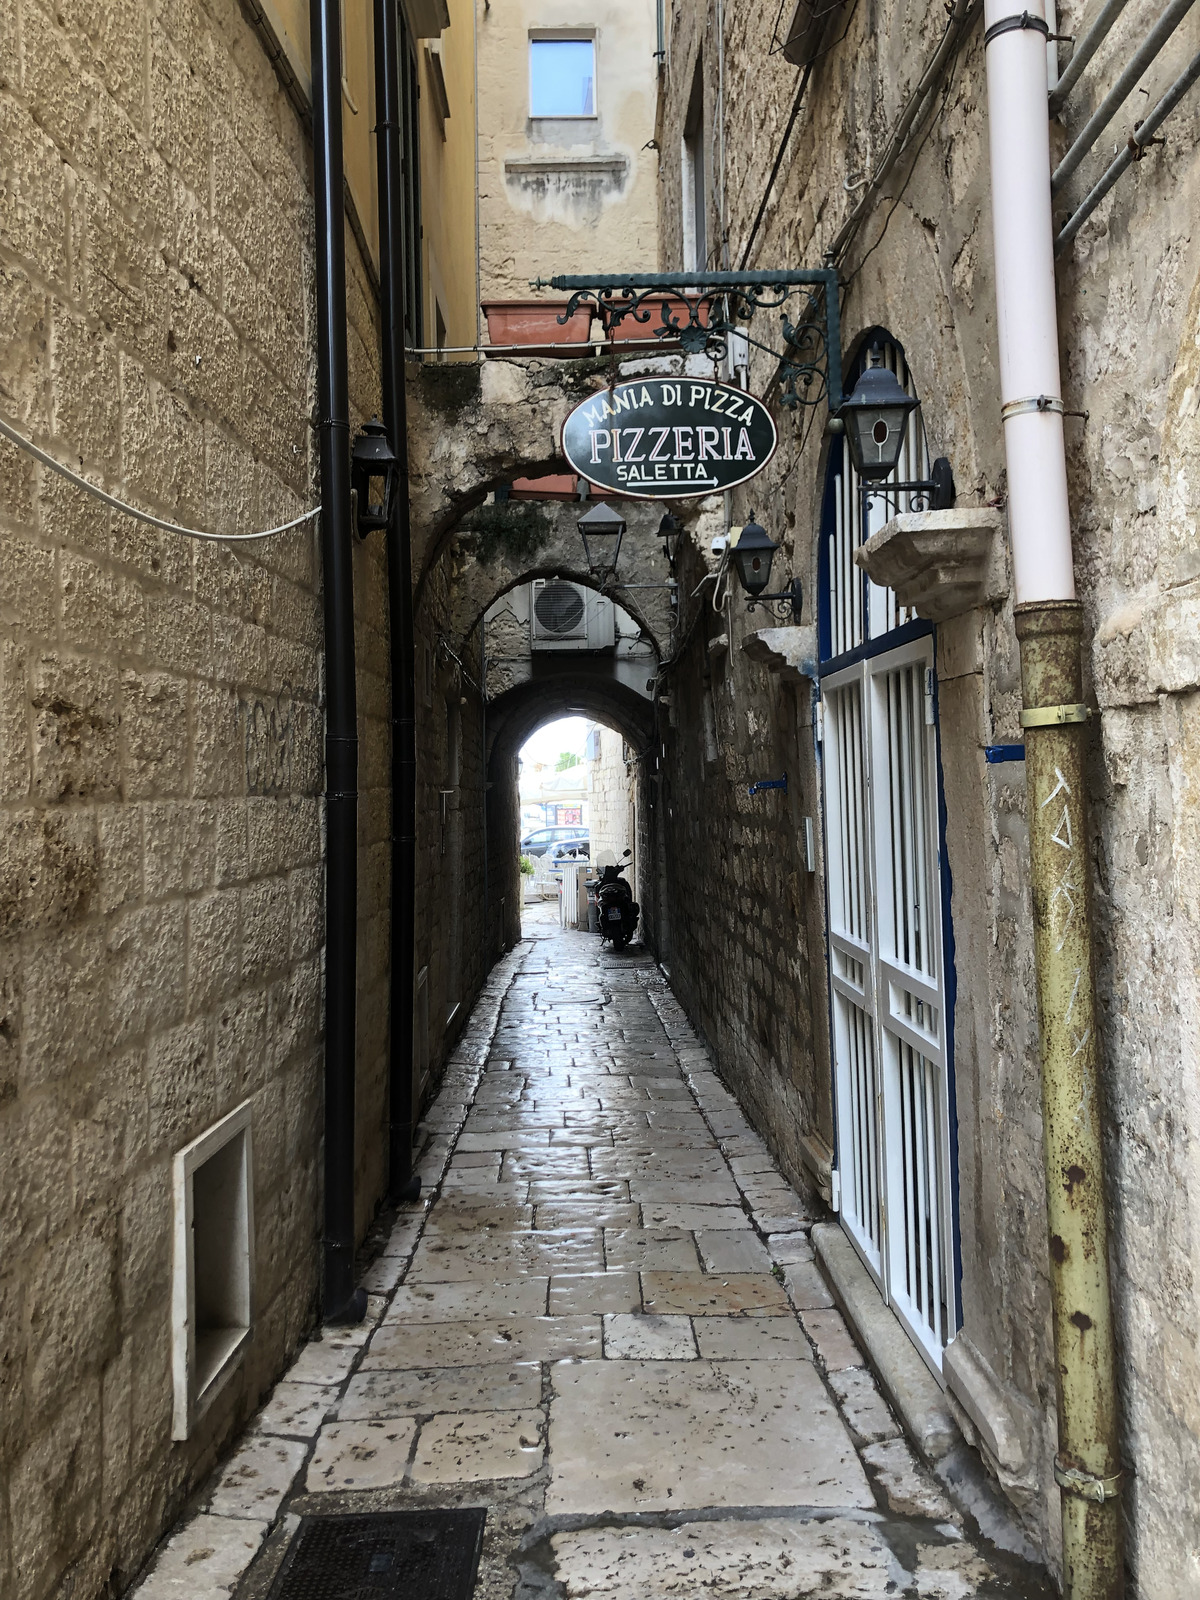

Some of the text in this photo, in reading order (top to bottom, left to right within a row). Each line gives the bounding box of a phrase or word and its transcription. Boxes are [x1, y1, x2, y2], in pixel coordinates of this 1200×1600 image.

[582, 384, 755, 428] MANIA DI PIZZA
[588, 426, 756, 464] PIZZERIA
[616, 463, 708, 481] SALETTA
